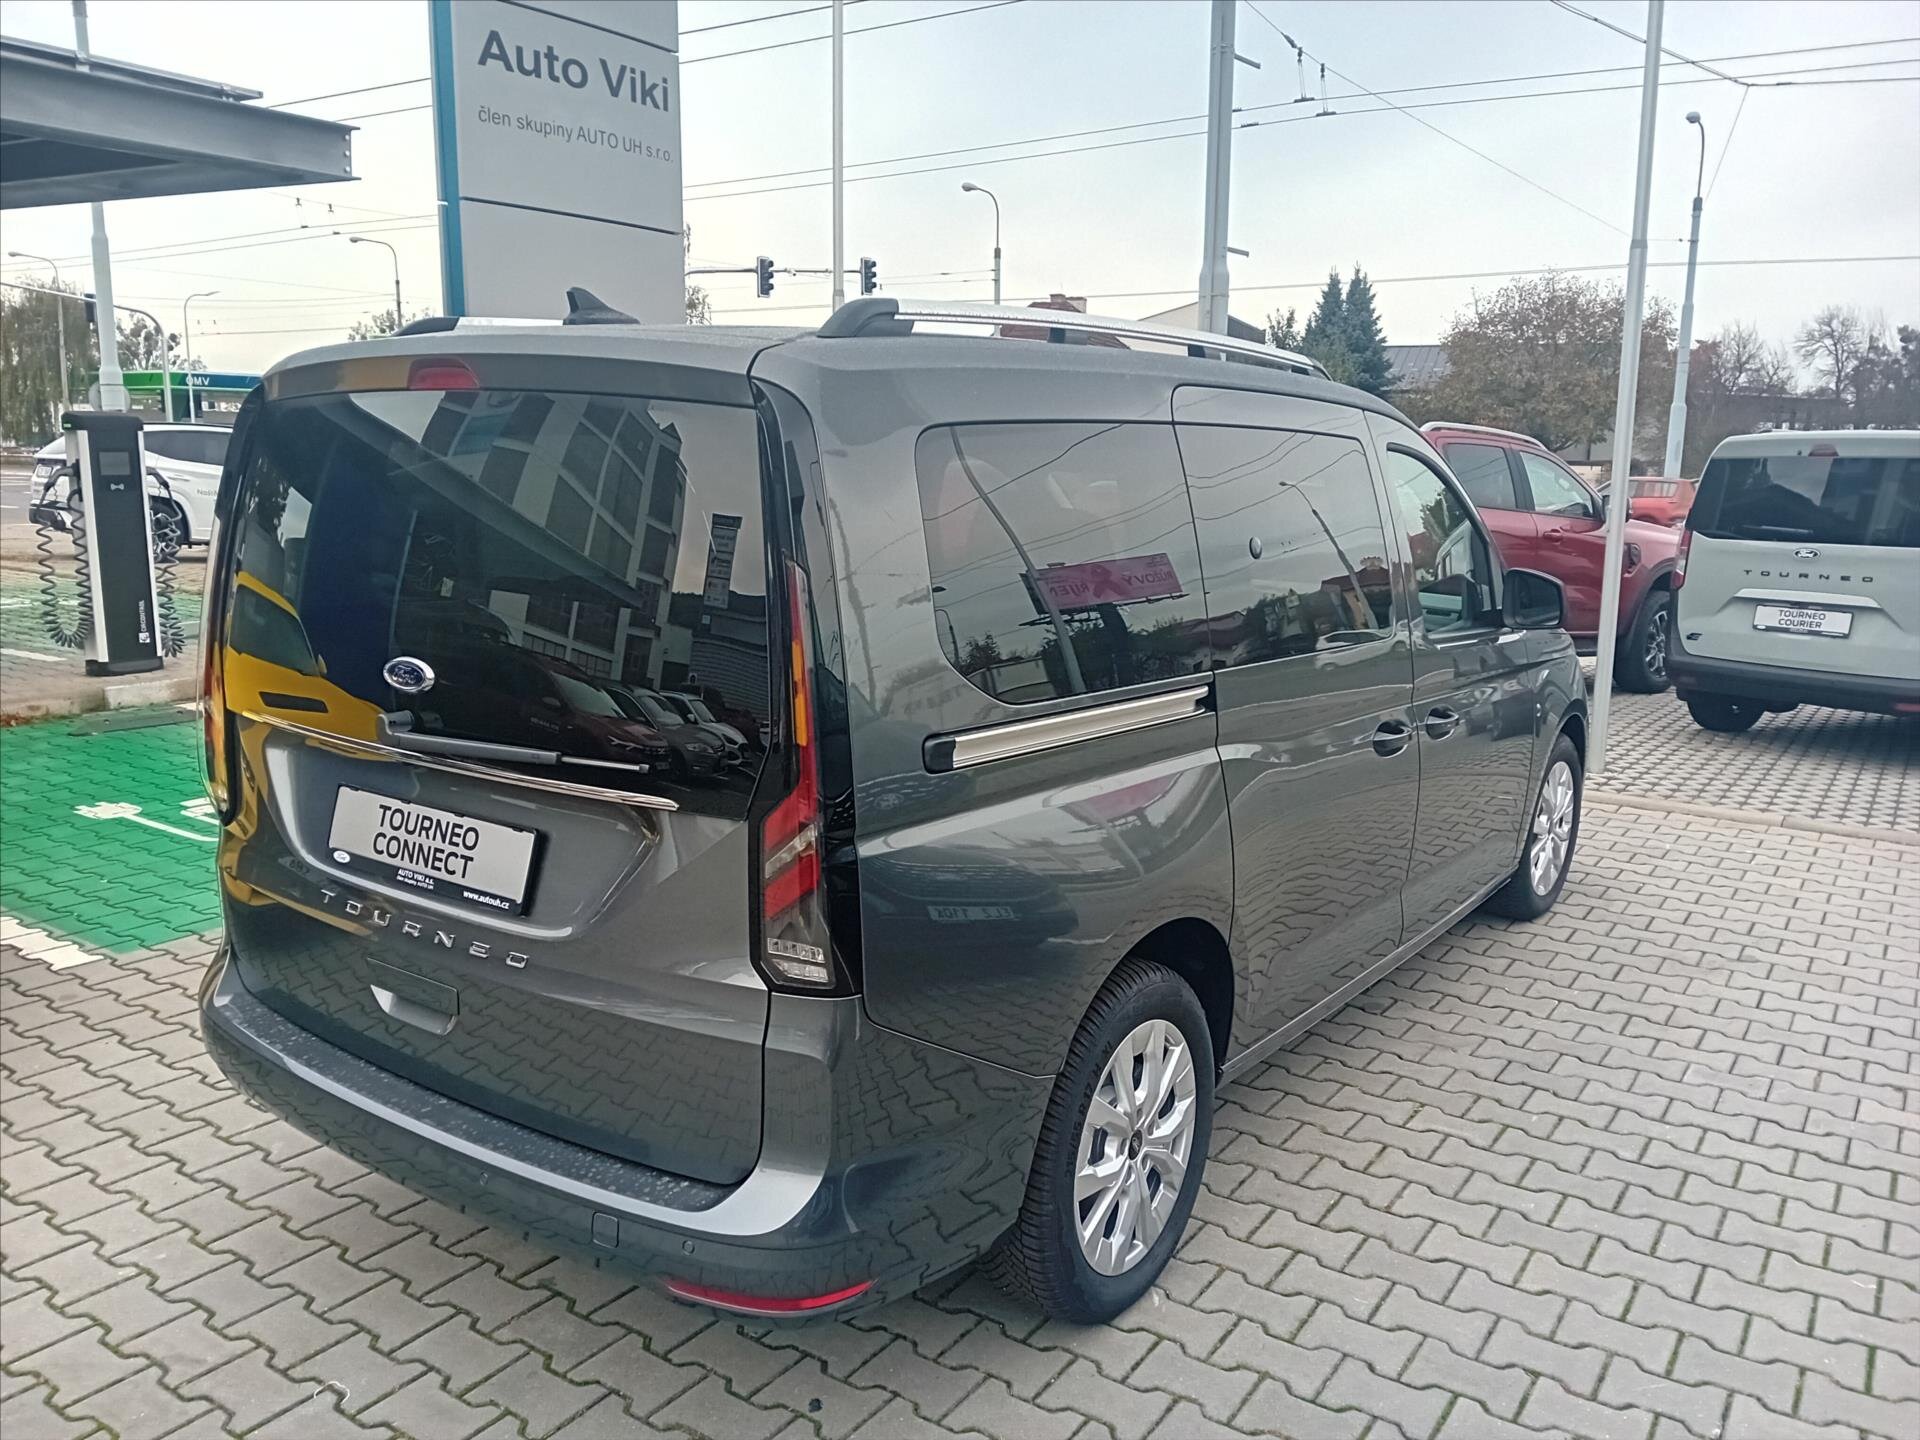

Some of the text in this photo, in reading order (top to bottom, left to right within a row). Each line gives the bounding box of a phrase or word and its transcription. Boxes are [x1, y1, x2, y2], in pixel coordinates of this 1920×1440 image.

[477, 29, 669, 112] Auto Viki
[478, 105, 674, 163] člen skupiny AUTO UH s.r.o.
[1743, 569, 1874, 583] TOURNEO
[1778, 609, 1826, 621] TOURNEO
[1778, 619, 1822, 629] COURIER
[379, 803, 479, 851] TOURNEO
[373, 832, 474, 879] CONNECT
[398, 868, 413, 878] AUTO
[413, 872, 425, 882] VIKI
[463, 890, 510, 910] www.autouh.cz
[320, 889, 531, 969] TOURNEO
